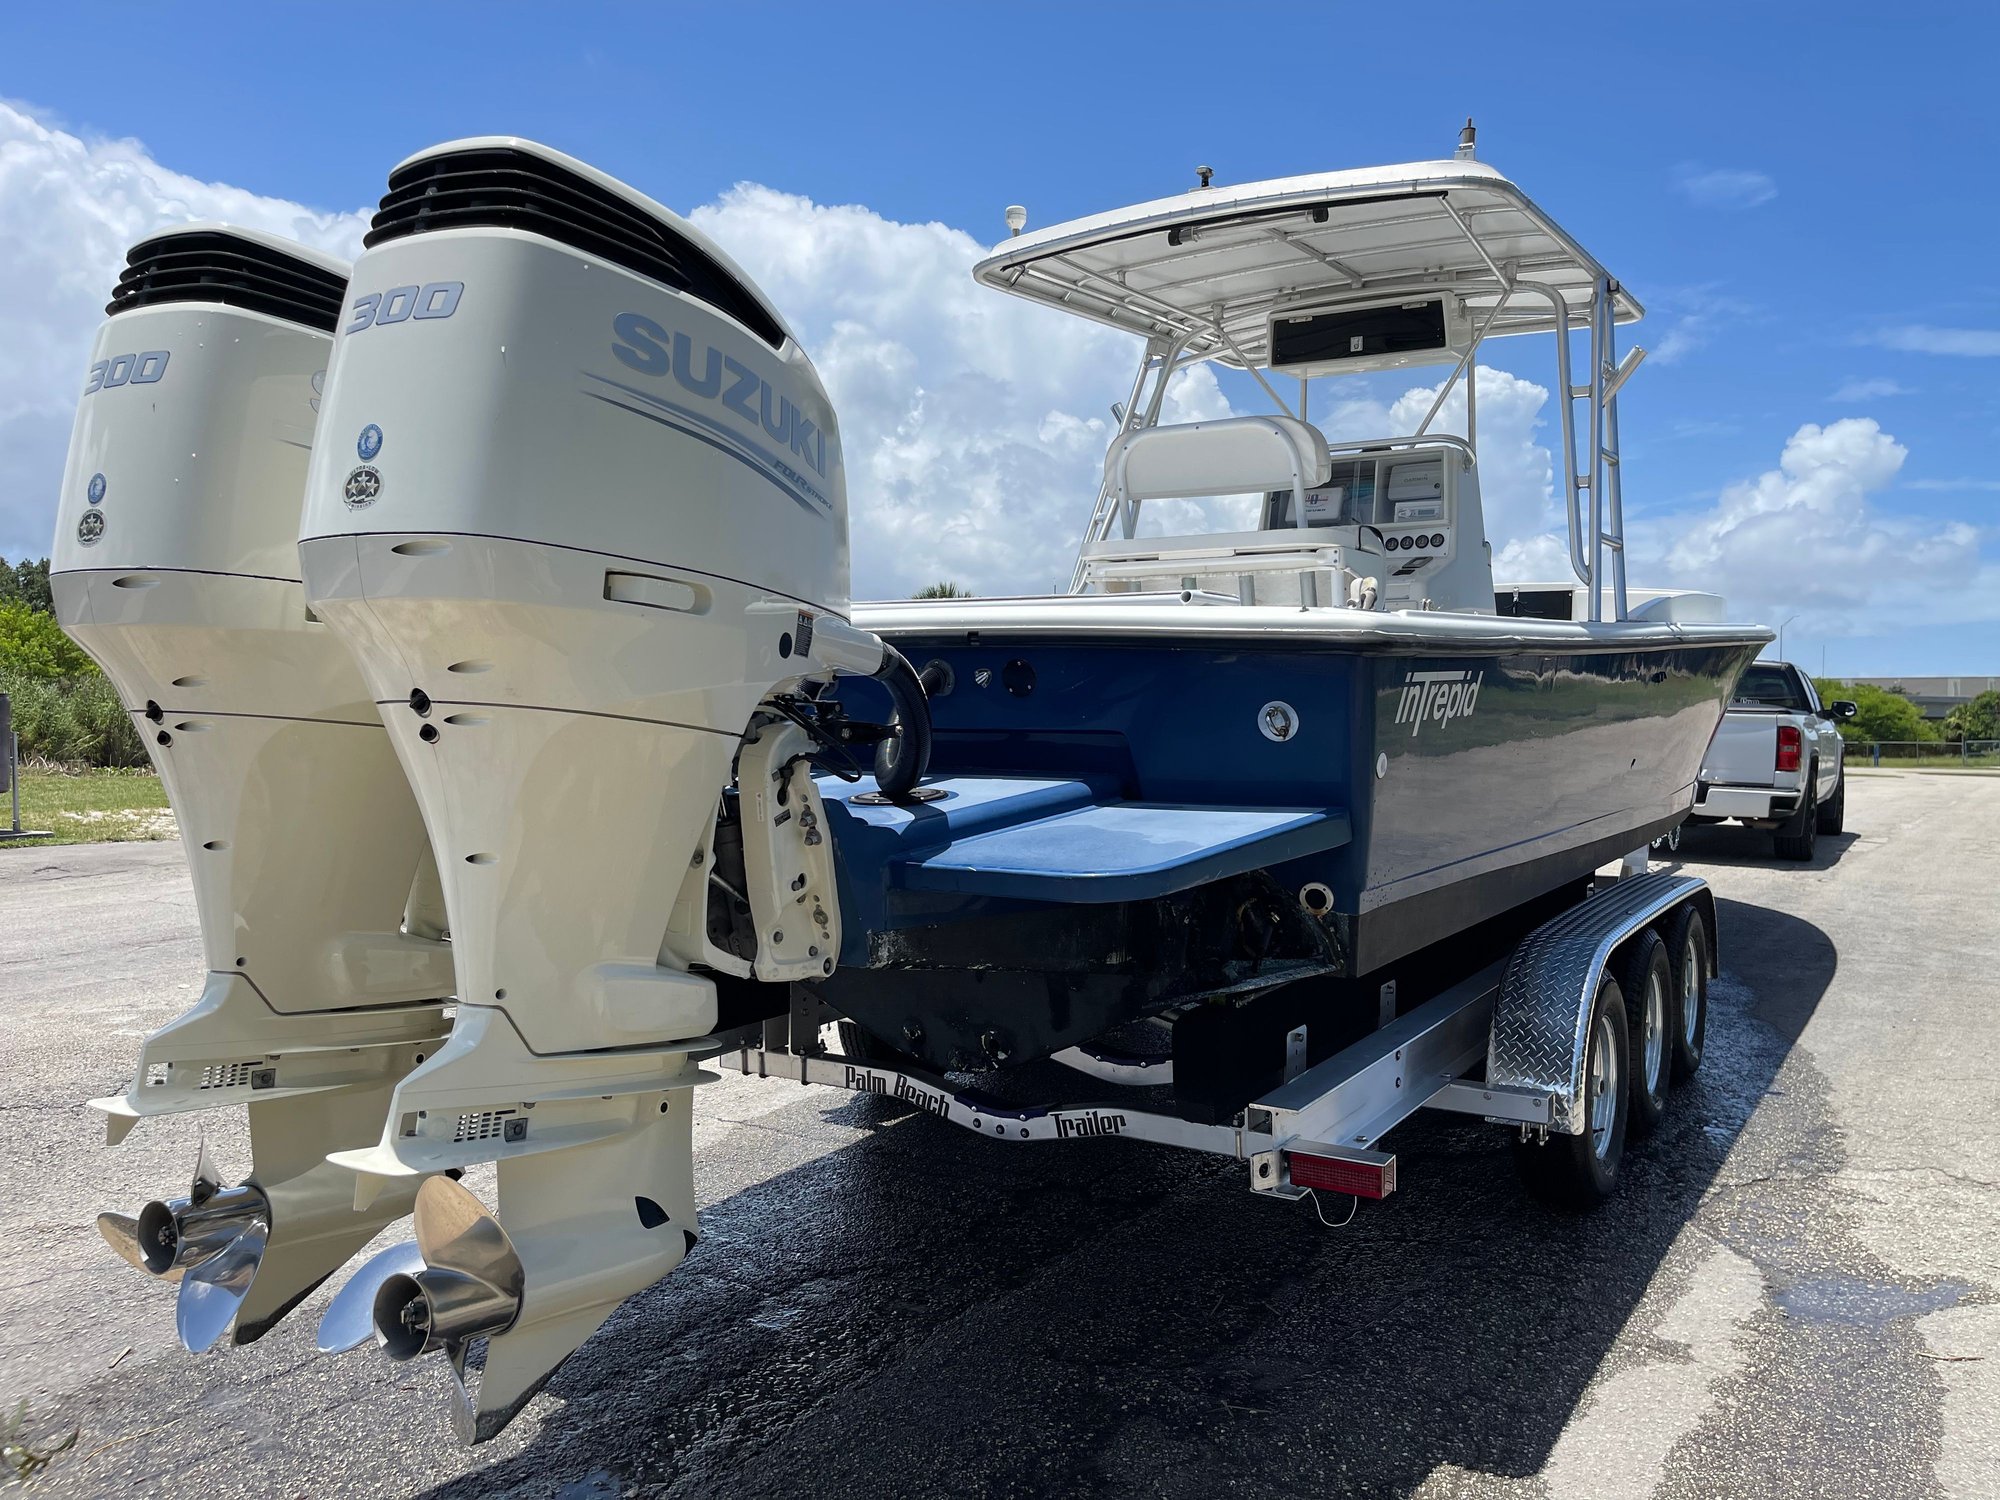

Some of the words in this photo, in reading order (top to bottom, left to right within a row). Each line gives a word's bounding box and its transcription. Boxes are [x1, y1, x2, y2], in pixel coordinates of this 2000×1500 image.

[345, 281, 465, 336] 300
[84, 350, 171, 397] 300
[611, 311, 826, 479] SUZUKI
[845, 1065, 887, 1095] Palm
[894, 1073, 950, 1120] Beach
[1049, 1110, 1127, 1138] Trailer
